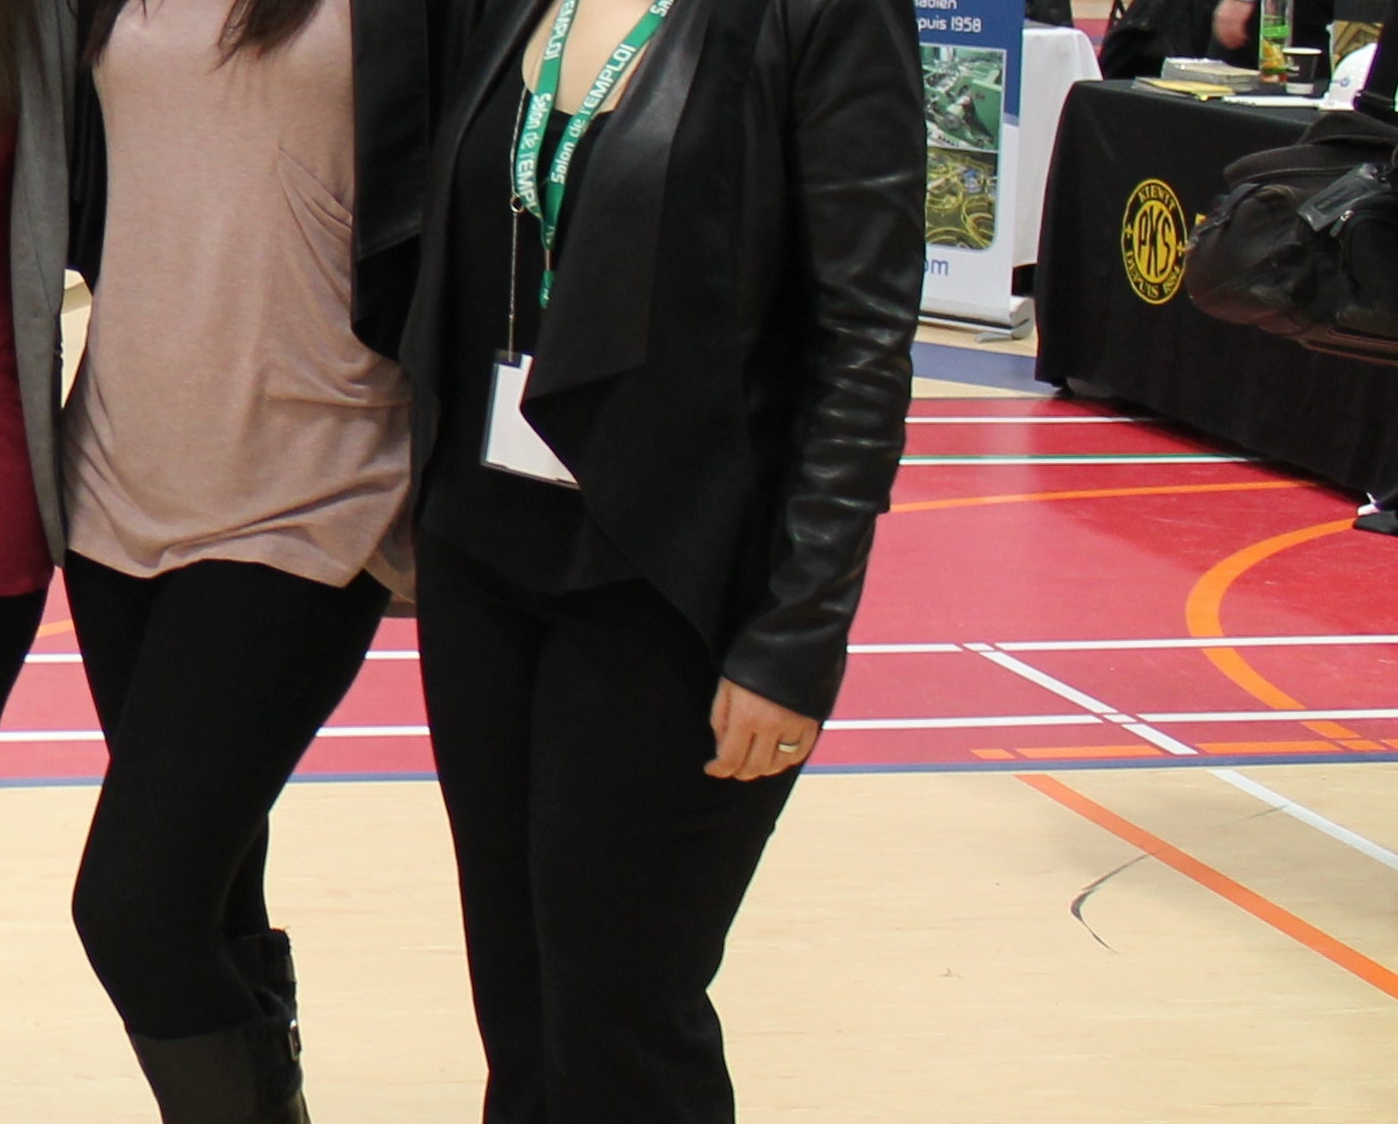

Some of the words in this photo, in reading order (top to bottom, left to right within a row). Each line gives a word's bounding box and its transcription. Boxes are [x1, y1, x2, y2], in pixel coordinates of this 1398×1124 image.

[917, 16, 947, 32] puis
[951, 17, 982, 33] 1958
[551, 142, 574, 185] Salon
[568, 118, 588, 139] de
[579, 44, 637, 116] l'EMPLOI
[1138, 205, 1172, 278] PKS
